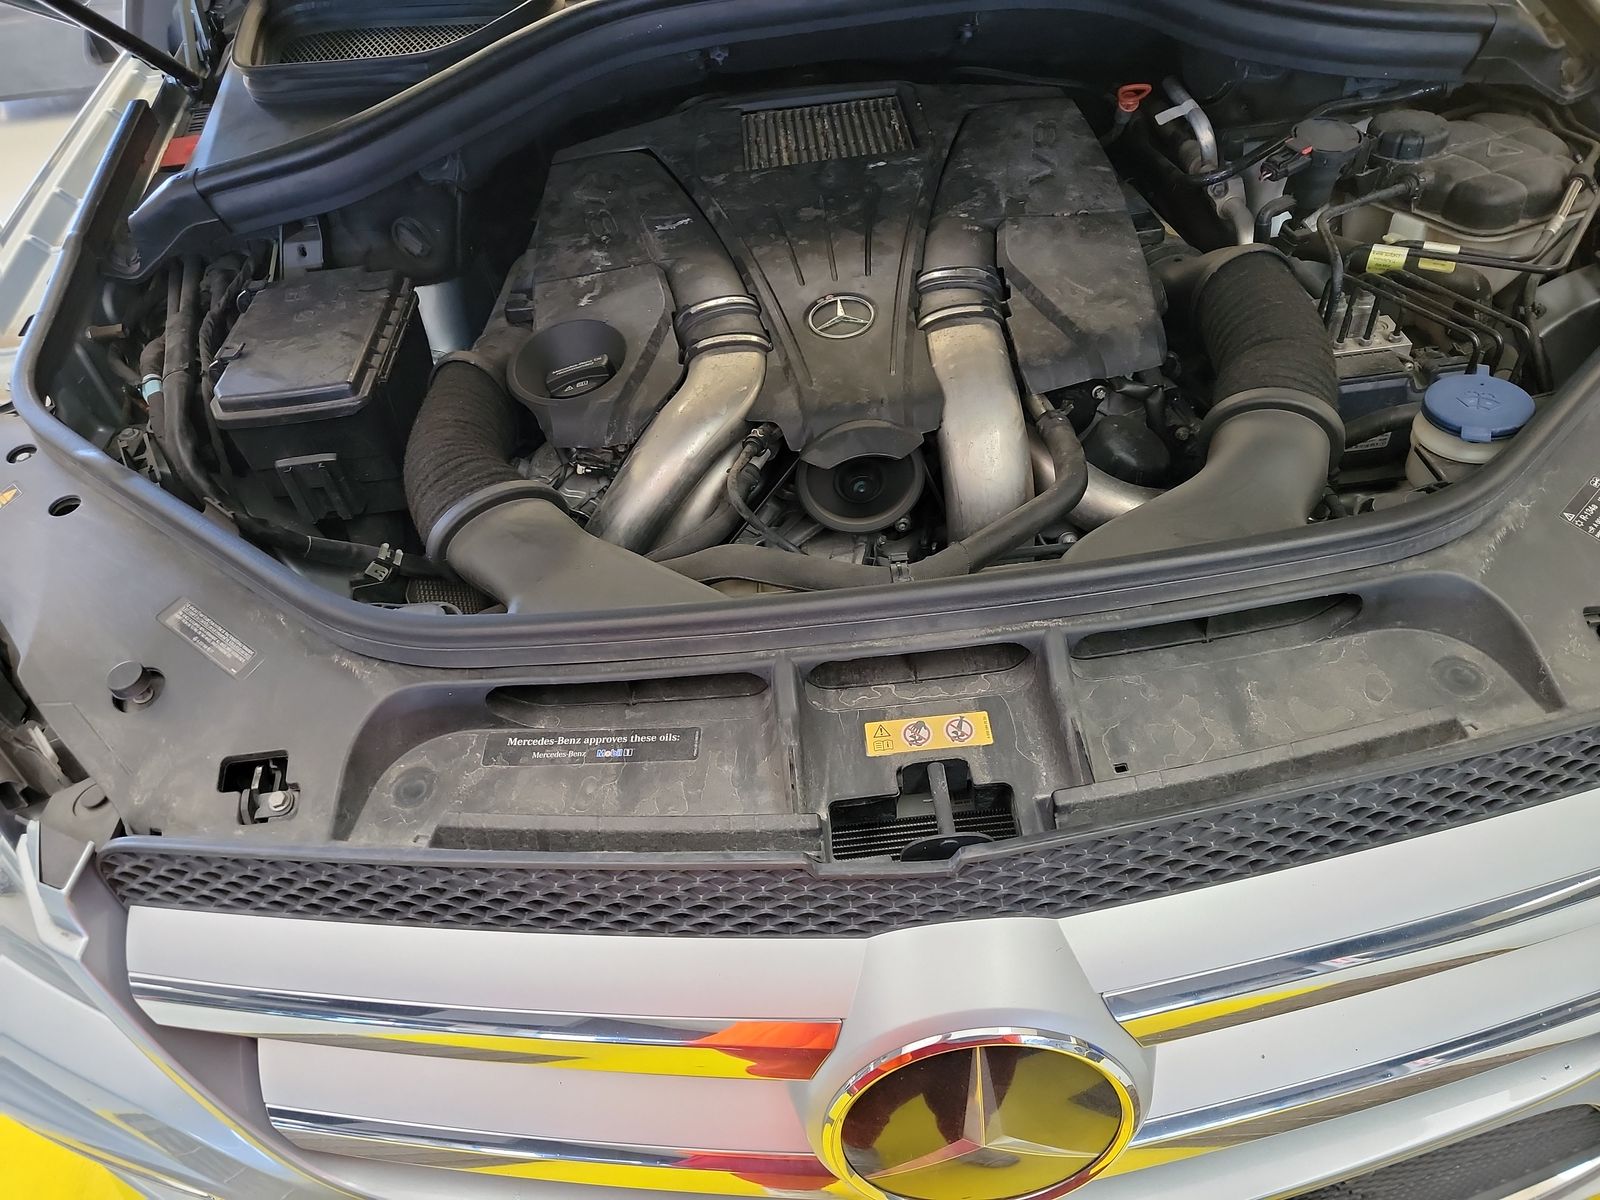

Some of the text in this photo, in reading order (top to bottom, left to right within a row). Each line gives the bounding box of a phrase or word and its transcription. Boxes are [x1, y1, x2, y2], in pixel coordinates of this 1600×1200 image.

[507, 732, 681, 746] Mercedes-Benz approves these oils:
[532, 750, 587, 759] Mercedes-Benz
[596, 749, 623, 758] Mobil
